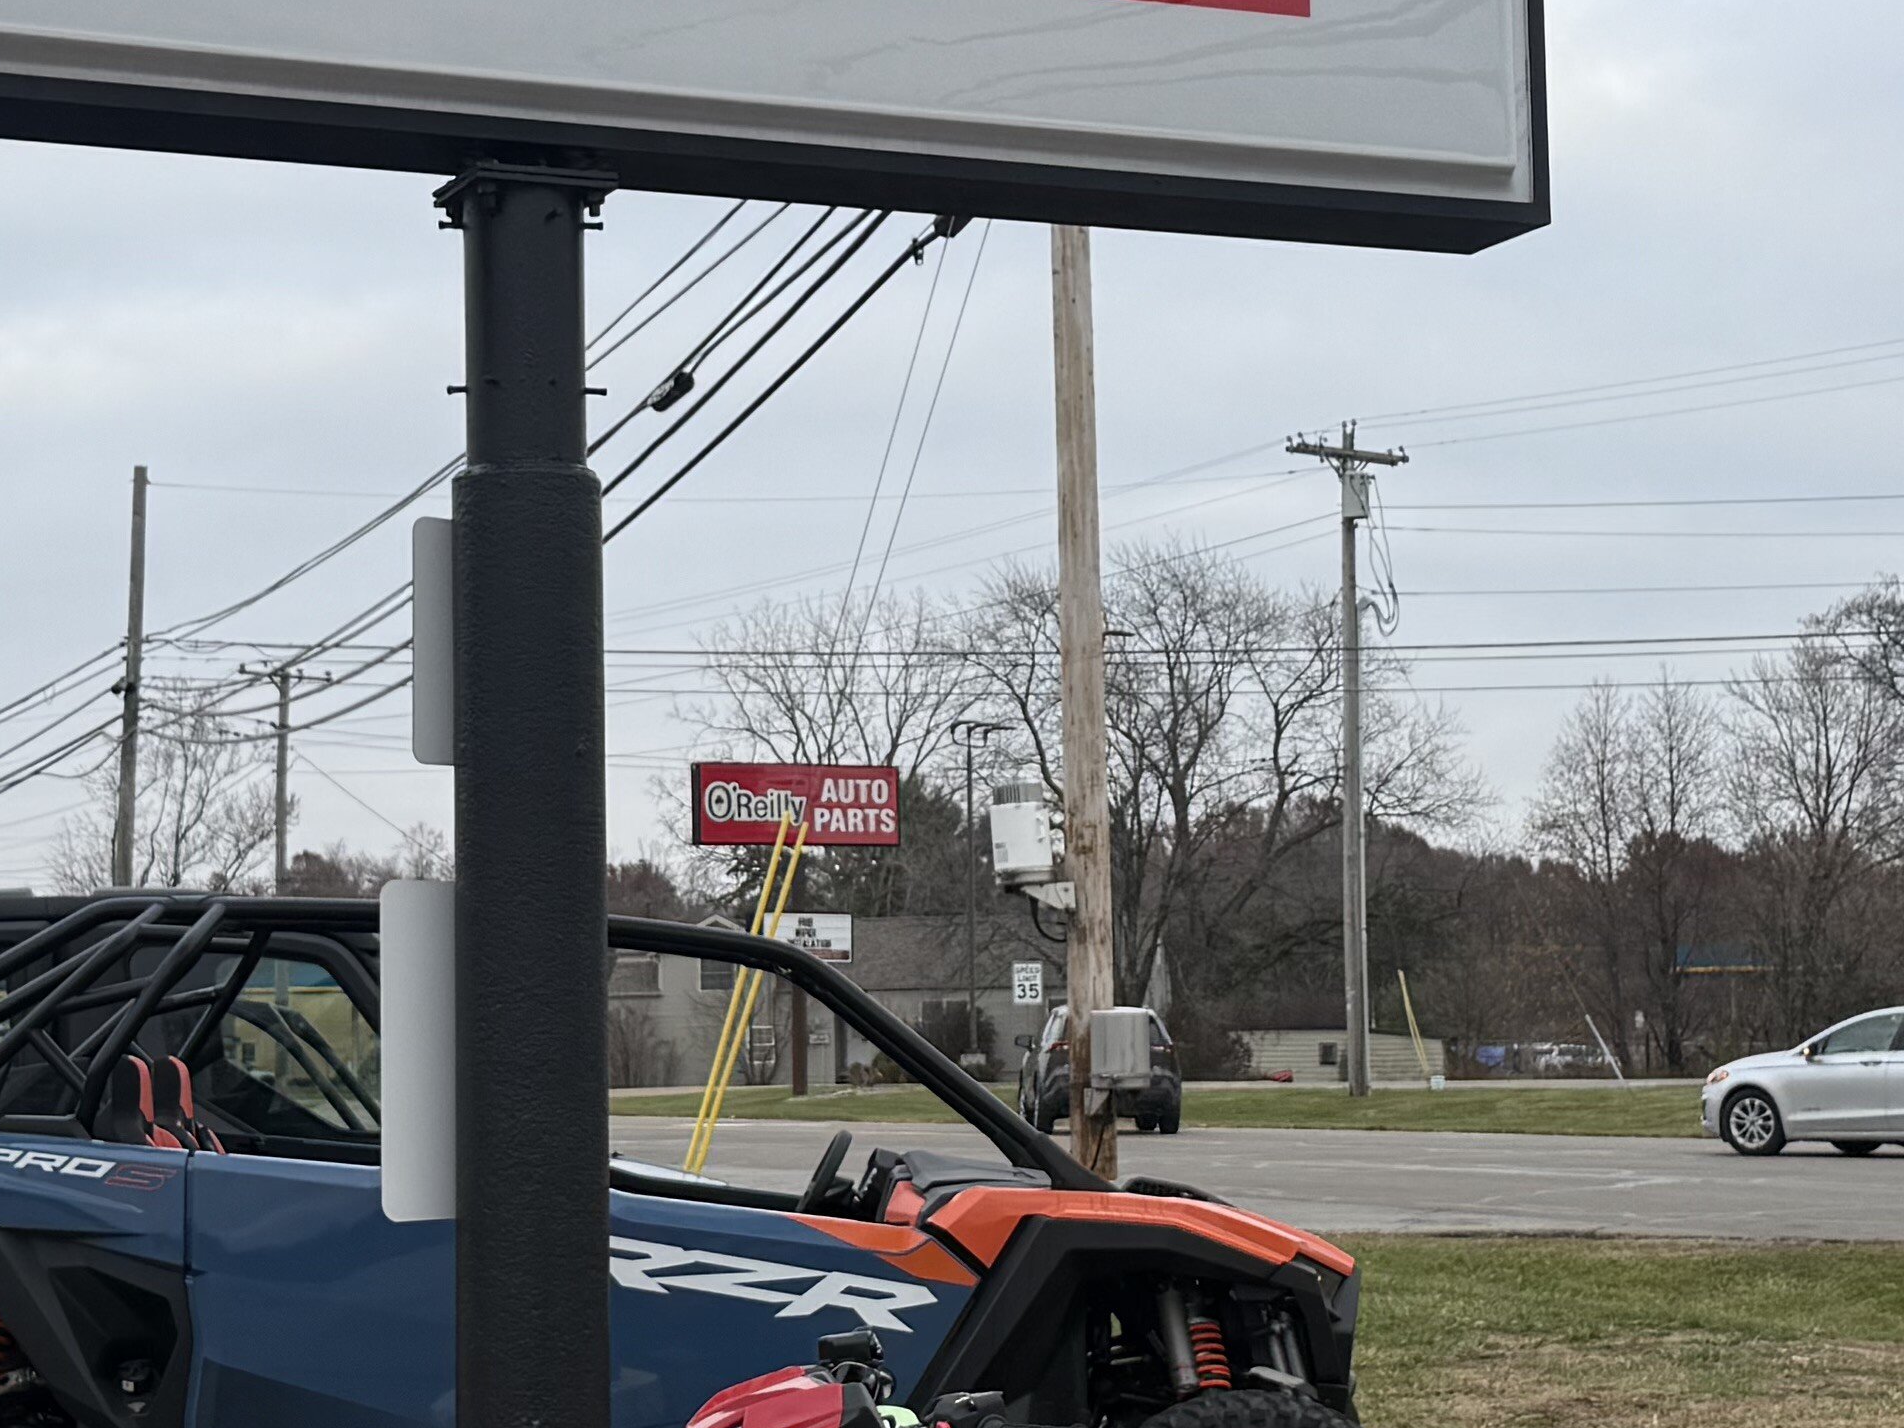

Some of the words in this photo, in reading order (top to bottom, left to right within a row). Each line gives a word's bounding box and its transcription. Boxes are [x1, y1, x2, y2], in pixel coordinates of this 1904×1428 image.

[707, 782, 805, 824] O'Reilly
[820, 778, 890, 804] AUTO
[813, 807, 896, 833] PARTS
[1017, 983, 1040, 999] 35
